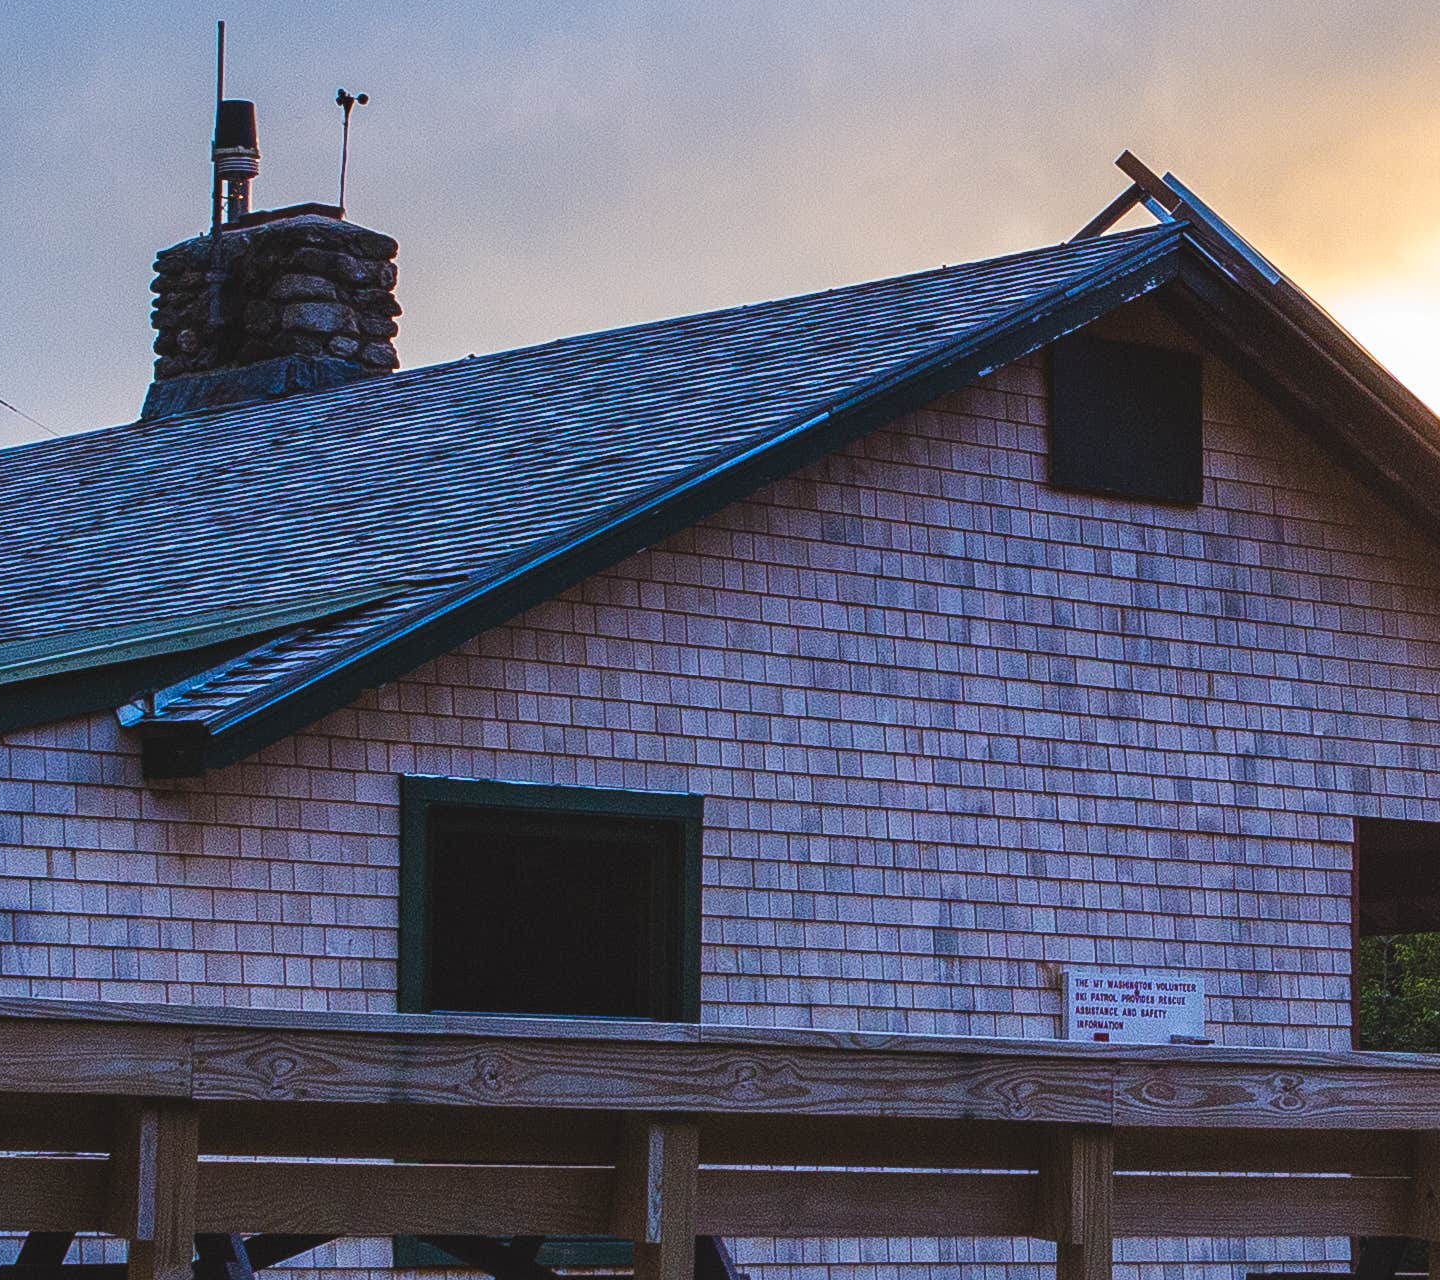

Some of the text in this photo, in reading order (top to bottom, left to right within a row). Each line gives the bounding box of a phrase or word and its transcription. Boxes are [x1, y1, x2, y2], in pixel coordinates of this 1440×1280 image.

[1075, 978, 1089, 988] THE
[1107, 980, 1152, 990] WASHINGTON
[1156, 982, 1196, 992] VOLUNTEER
[1075, 992, 1185, 1005] SKI PATROL PROVIDES RESCUE
[1075, 1006, 1167, 1019] ASSISTANCE AND SAFETY
[1077, 1019, 1124, 1030] INFORMATION
